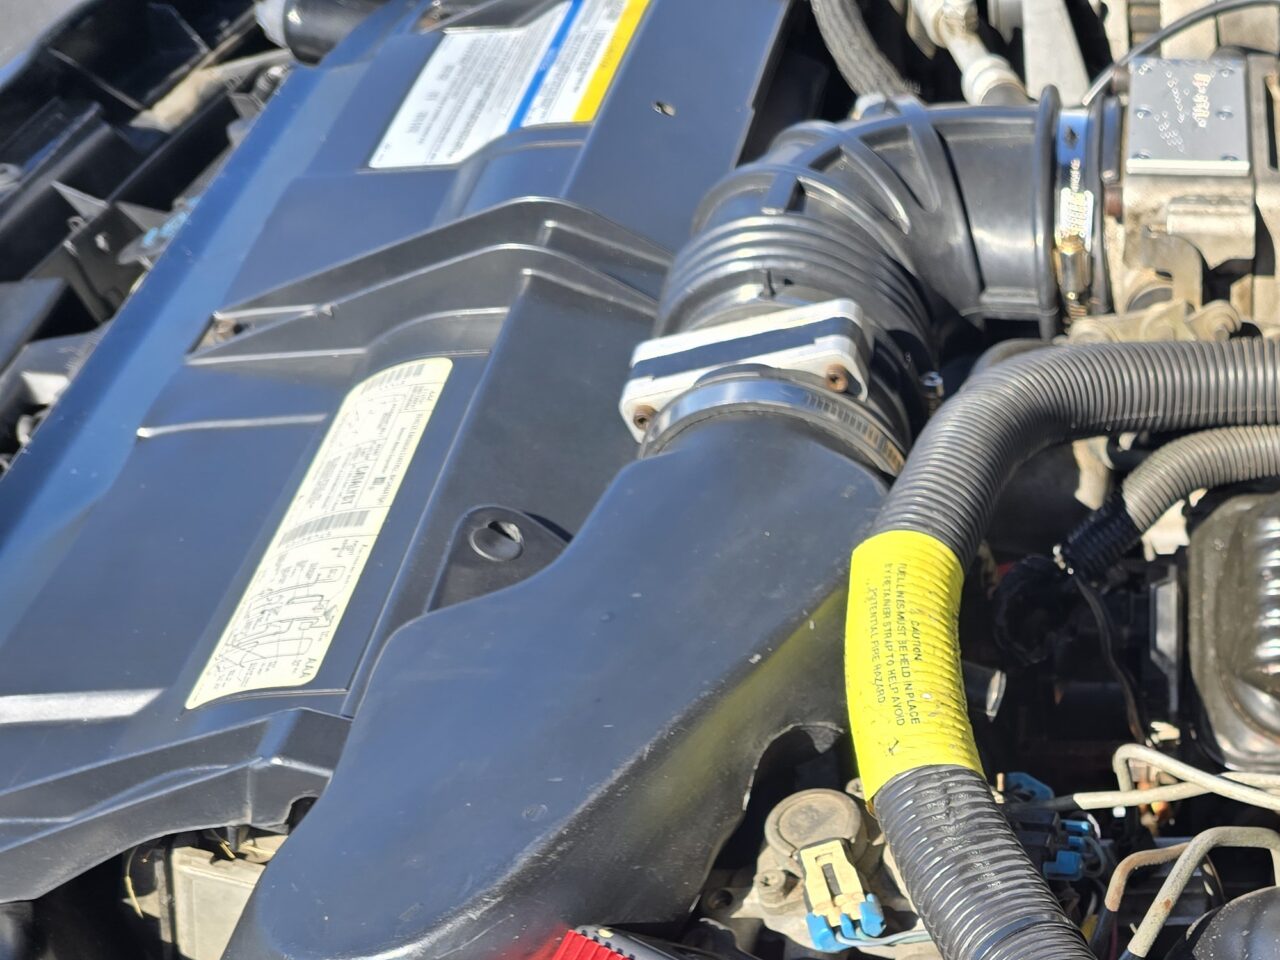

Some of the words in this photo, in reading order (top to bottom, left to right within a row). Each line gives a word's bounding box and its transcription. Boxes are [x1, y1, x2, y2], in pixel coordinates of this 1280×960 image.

[897, 611, 907, 636] MUST
[910, 620, 923, 661] CAUTION
[885, 653, 895, 666] TO
[900, 654, 911, 678] HELD
[888, 669, 899, 694] HELP
[891, 696, 906, 726] AVOID
[906, 692, 921, 725] PLACE
